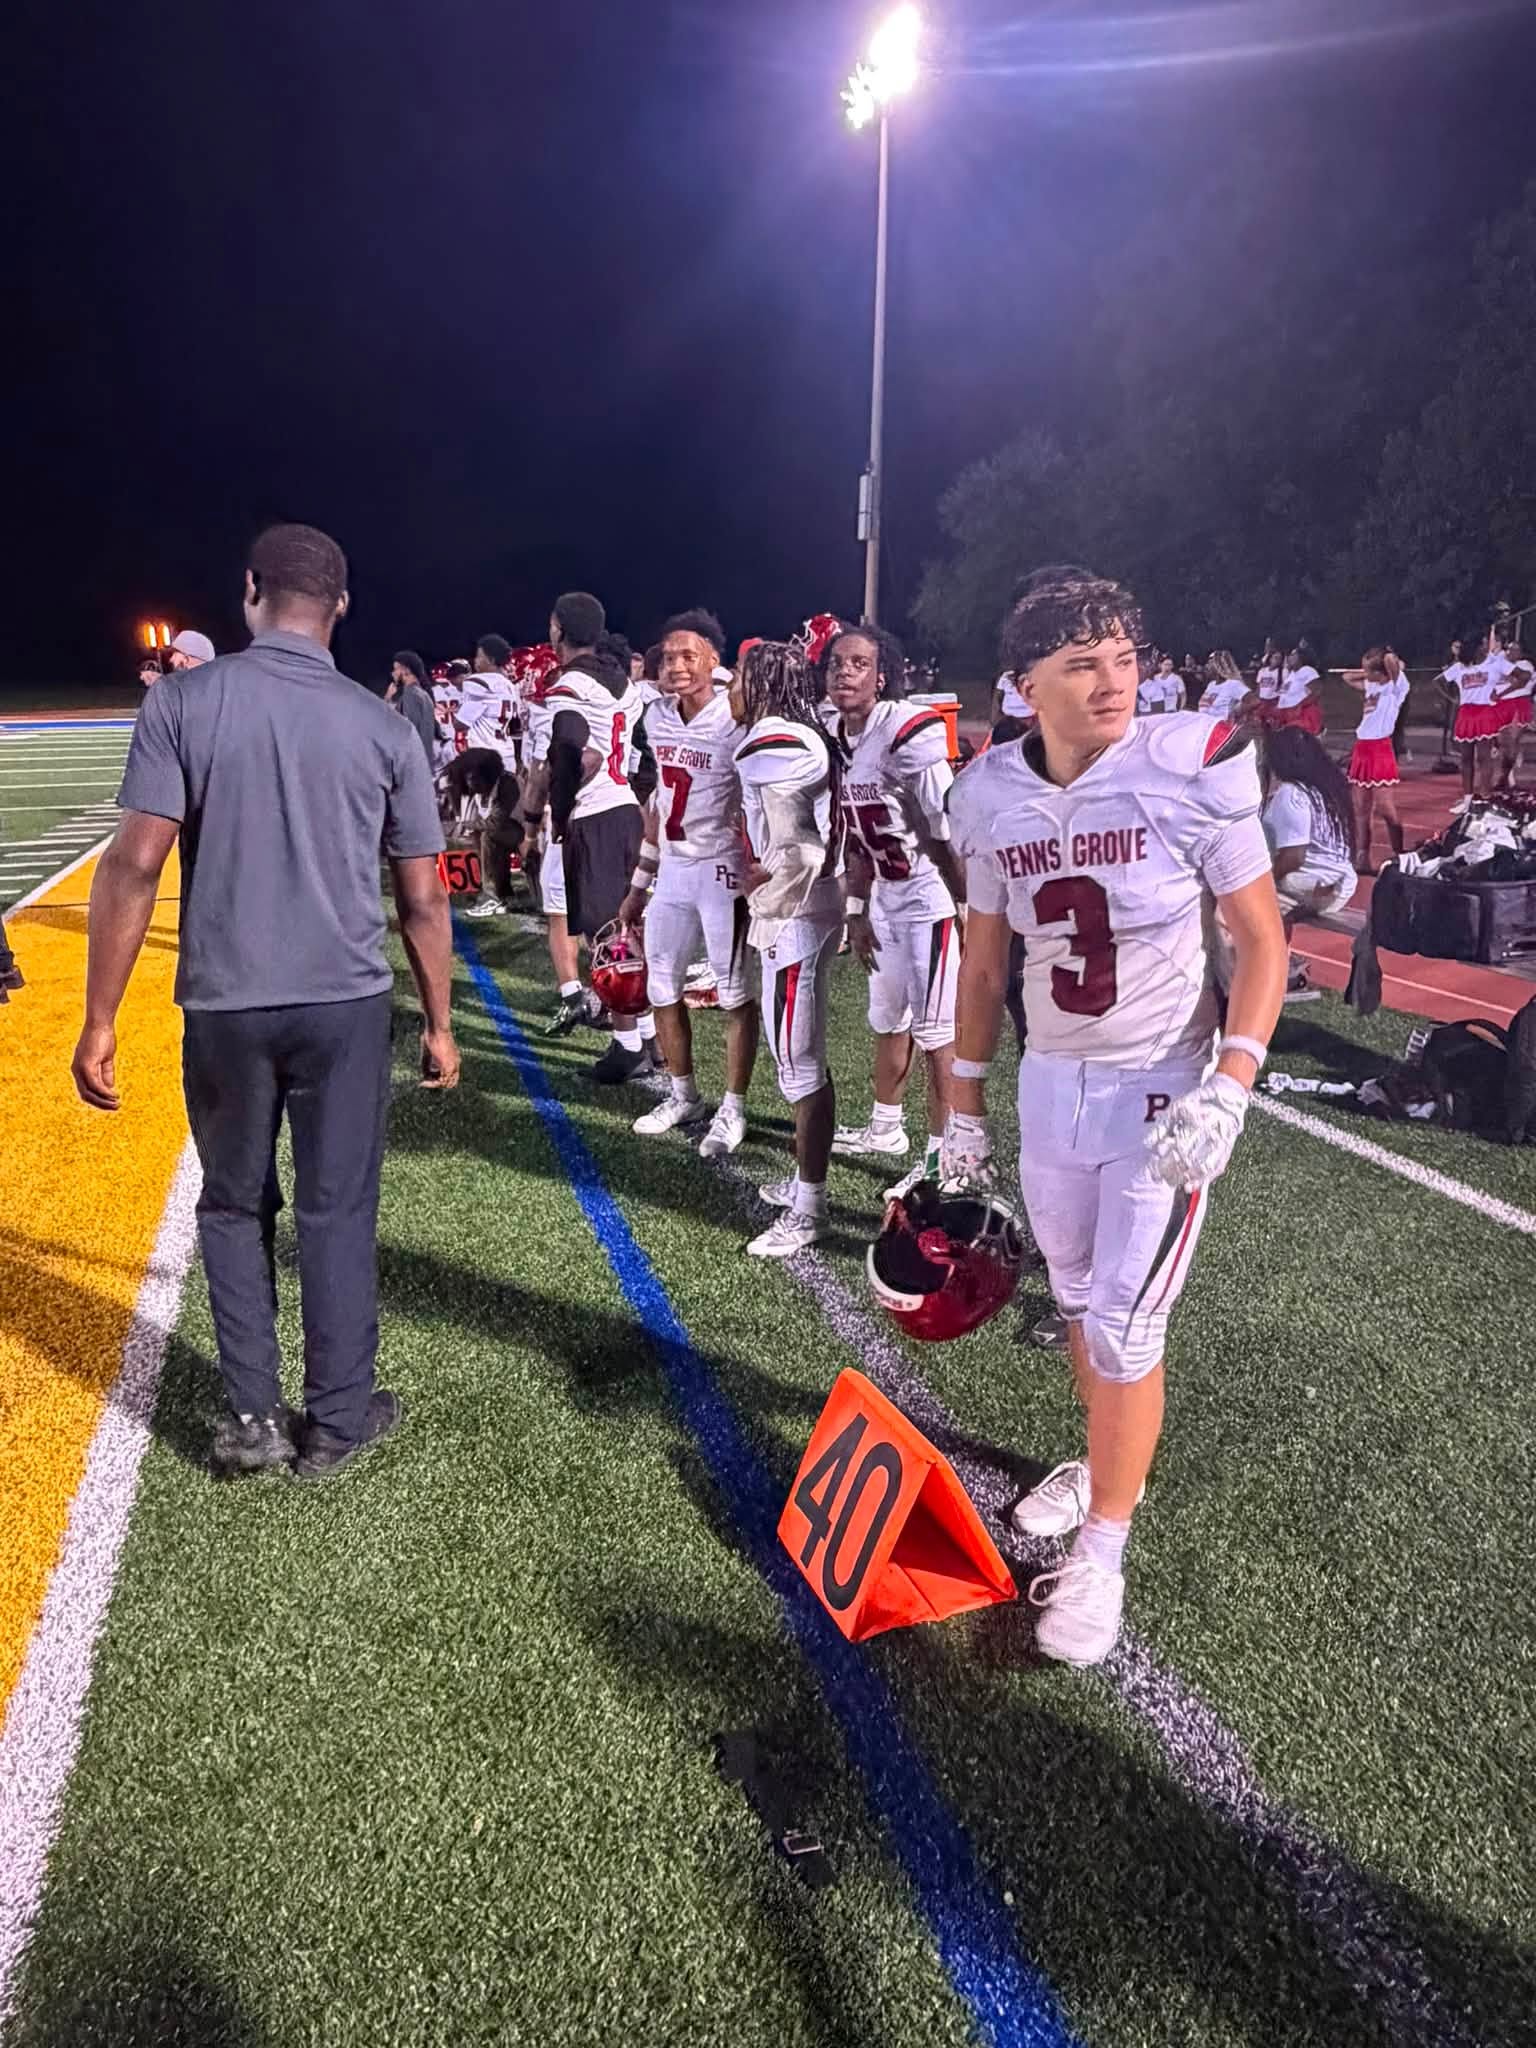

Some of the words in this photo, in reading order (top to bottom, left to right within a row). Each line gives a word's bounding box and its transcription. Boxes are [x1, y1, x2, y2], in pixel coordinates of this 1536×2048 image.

[678, 748, 713, 770] GROVE
[662, 765, 693, 841] 7
[1072, 827, 1148, 868] GROVE
[447, 852, 482, 890] 50
[715, 864, 738, 890] PG
[1032, 875, 1118, 1017] 3
[1144, 1093, 1171, 1123] P
[794, 1412, 903, 1611] 40
